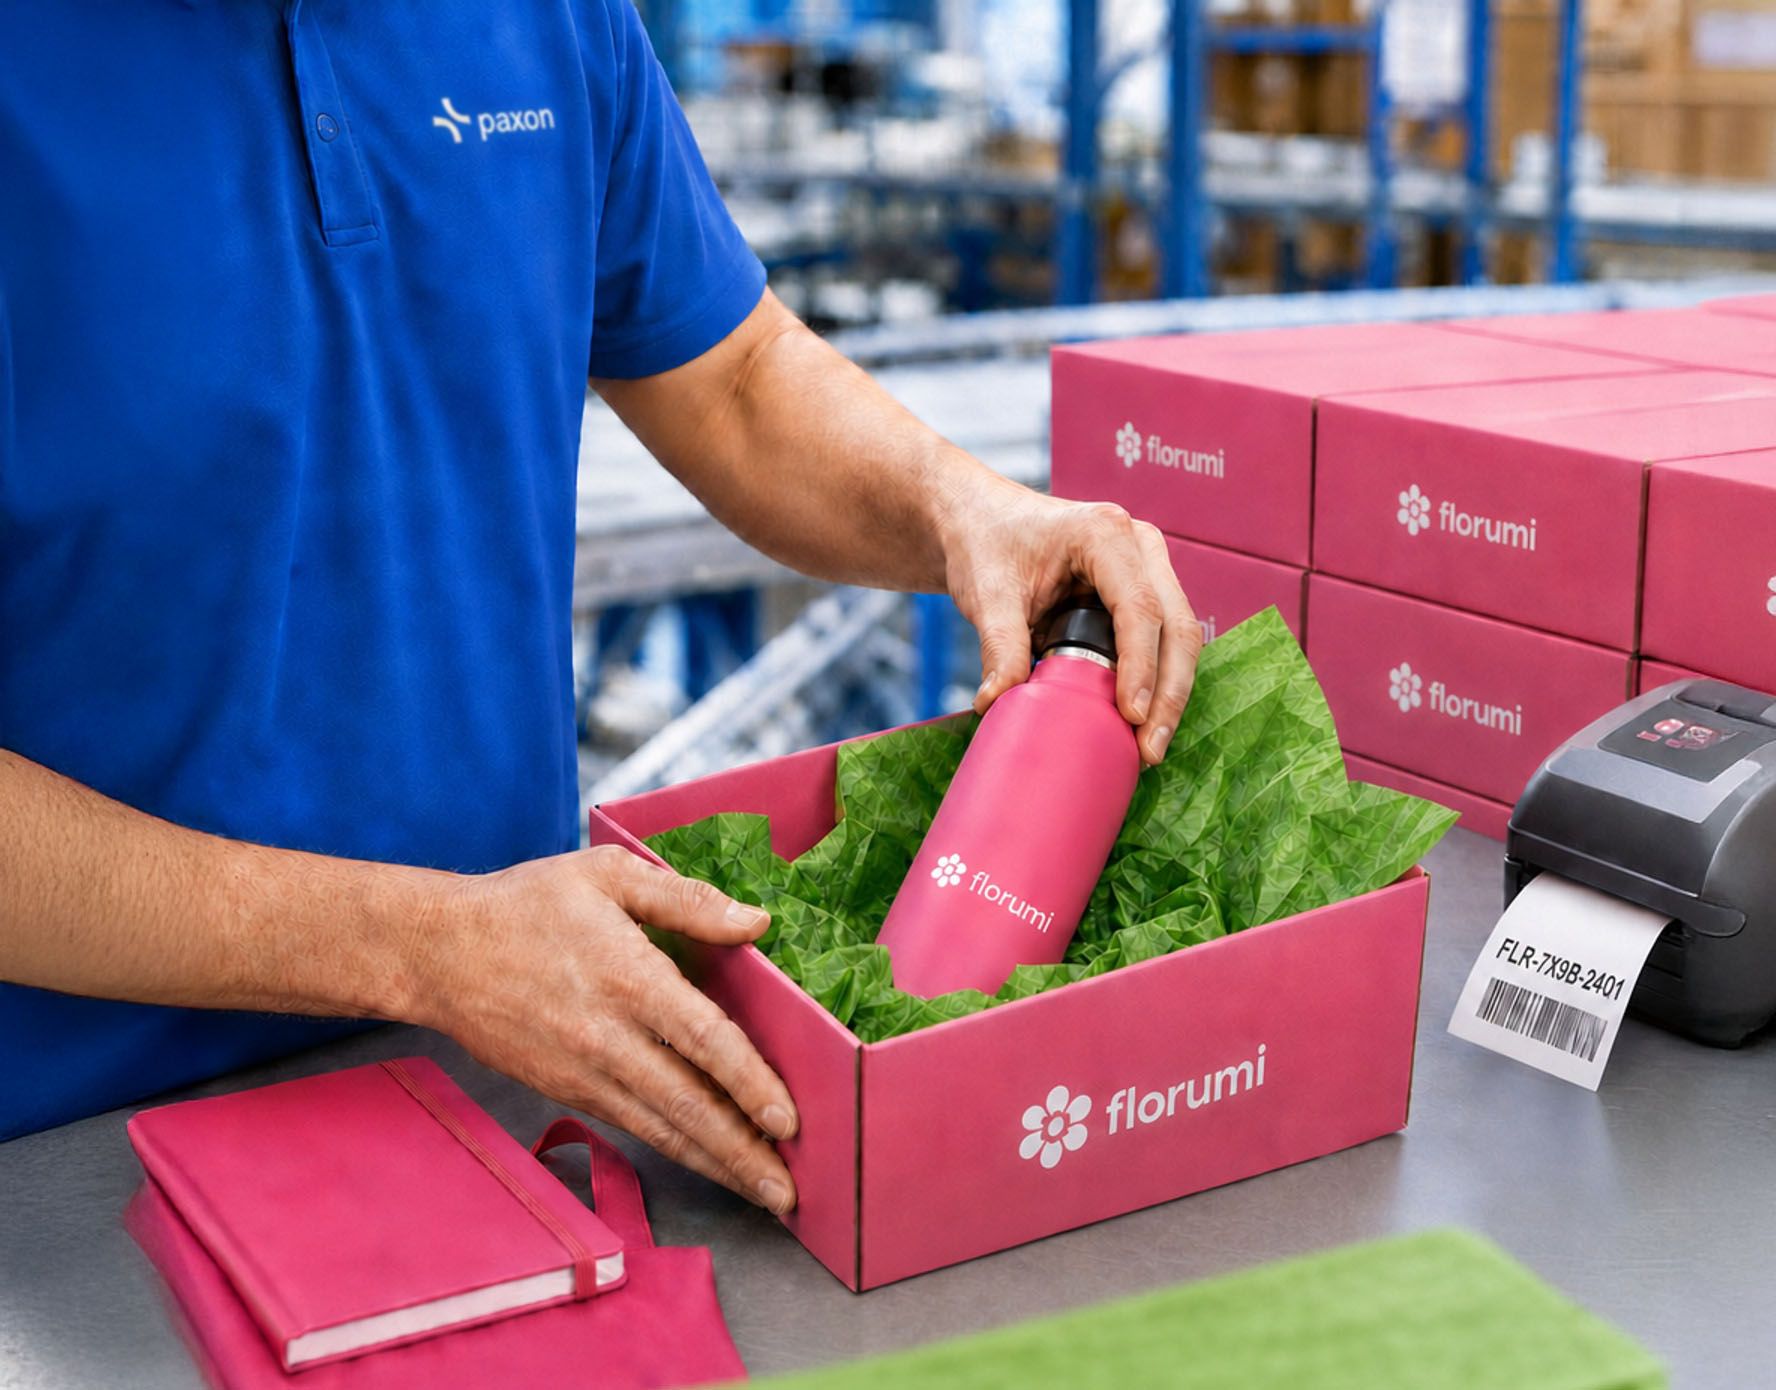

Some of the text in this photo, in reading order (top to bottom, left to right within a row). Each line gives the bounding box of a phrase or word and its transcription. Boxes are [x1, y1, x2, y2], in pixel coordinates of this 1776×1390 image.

[478, 107, 555, 141] paxon
[1147, 434, 1225, 478] florumi
[1439, 500, 1536, 551] florumi
[1428, 681, 1522, 735] florumi
[969, 871, 1055, 933] florumi
[1496, 938, 1625, 1001] FLR-7X9B-2401
[1106, 1043, 1267, 1135] florumi
